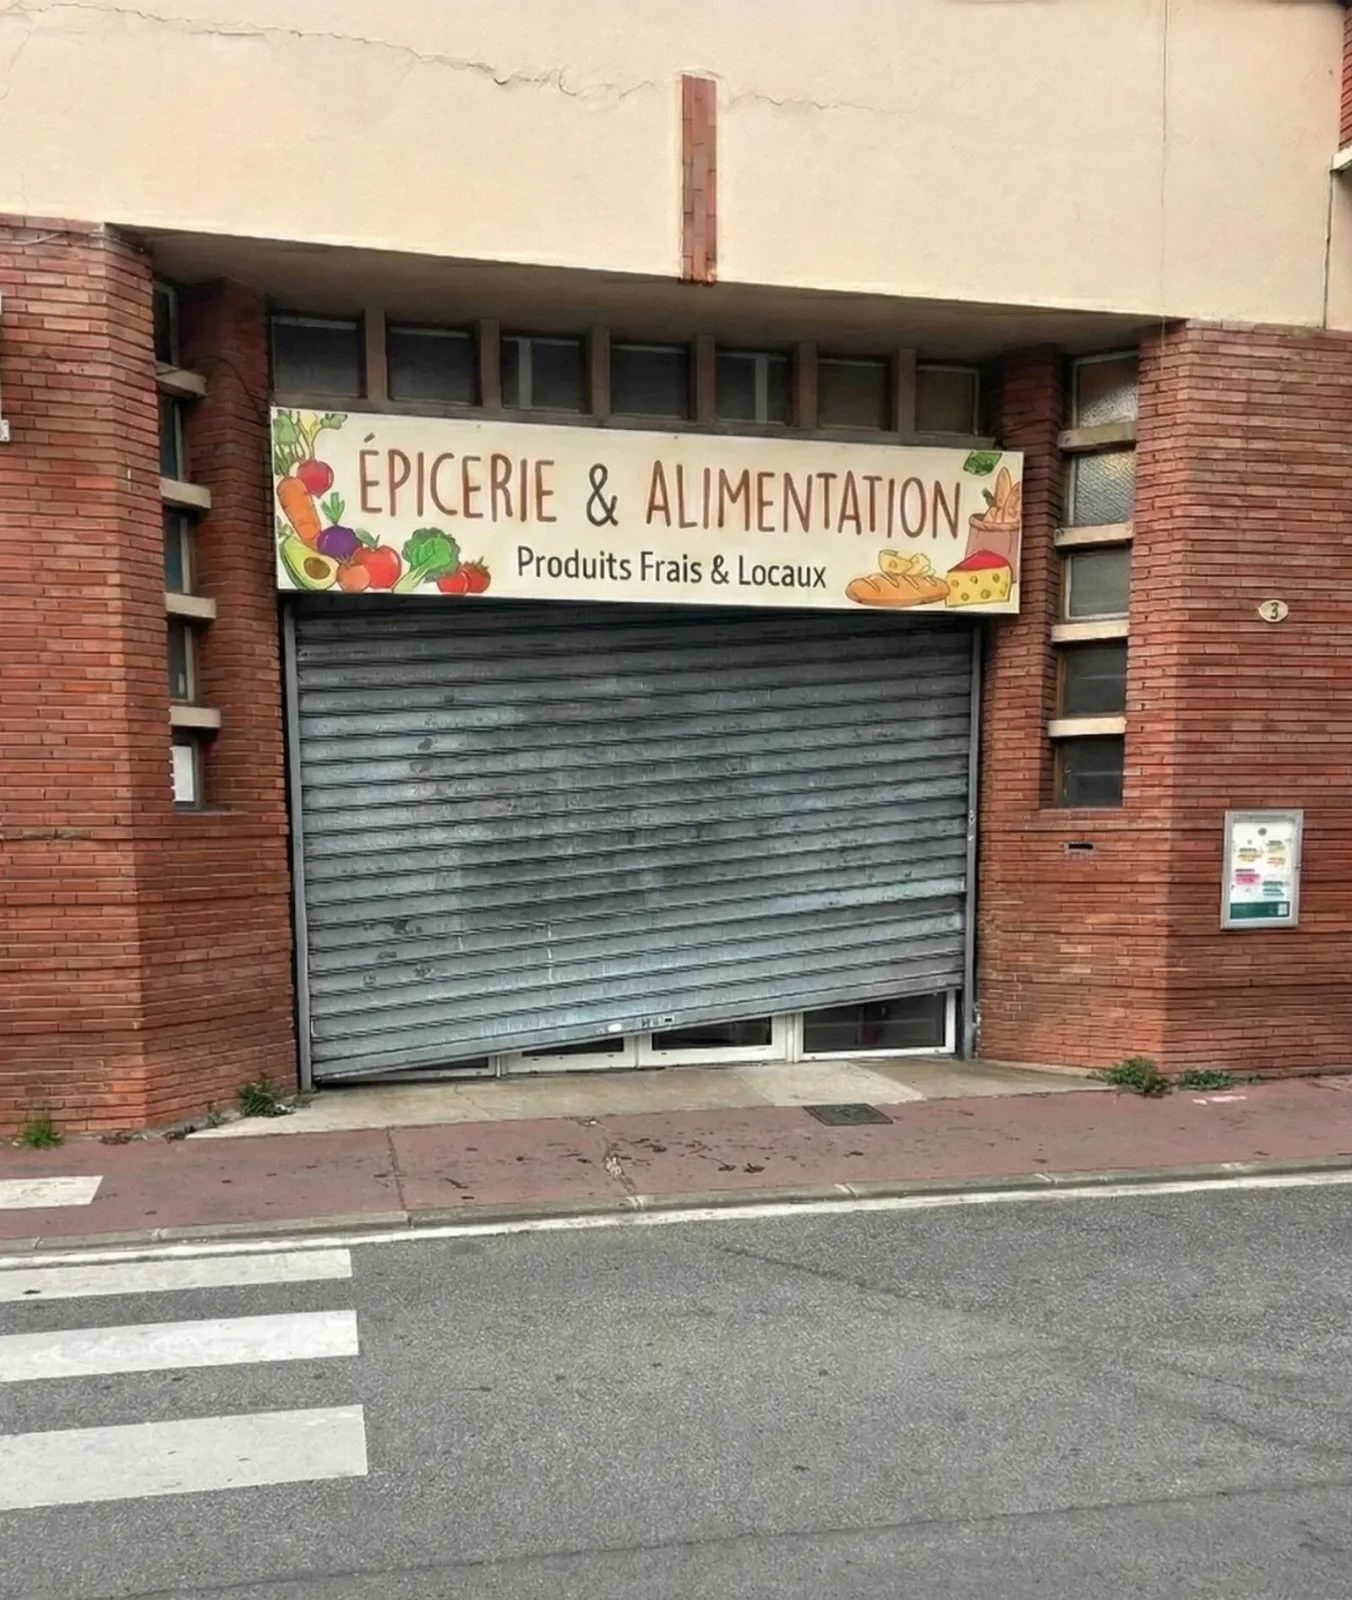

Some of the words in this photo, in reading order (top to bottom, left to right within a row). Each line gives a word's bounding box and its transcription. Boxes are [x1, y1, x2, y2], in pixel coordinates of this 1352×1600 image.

[359, 433, 557, 522] ÉPICERIE
[586, 463, 619, 527] &
[646, 459, 960, 540] ALIMENTATION
[517, 545, 632, 581] Produits
[640, 550, 702, 583] Frais
[710, 554, 729, 585] &
[738, 555, 827, 589] Locaux
[1270, 602, 1280, 619] 3
